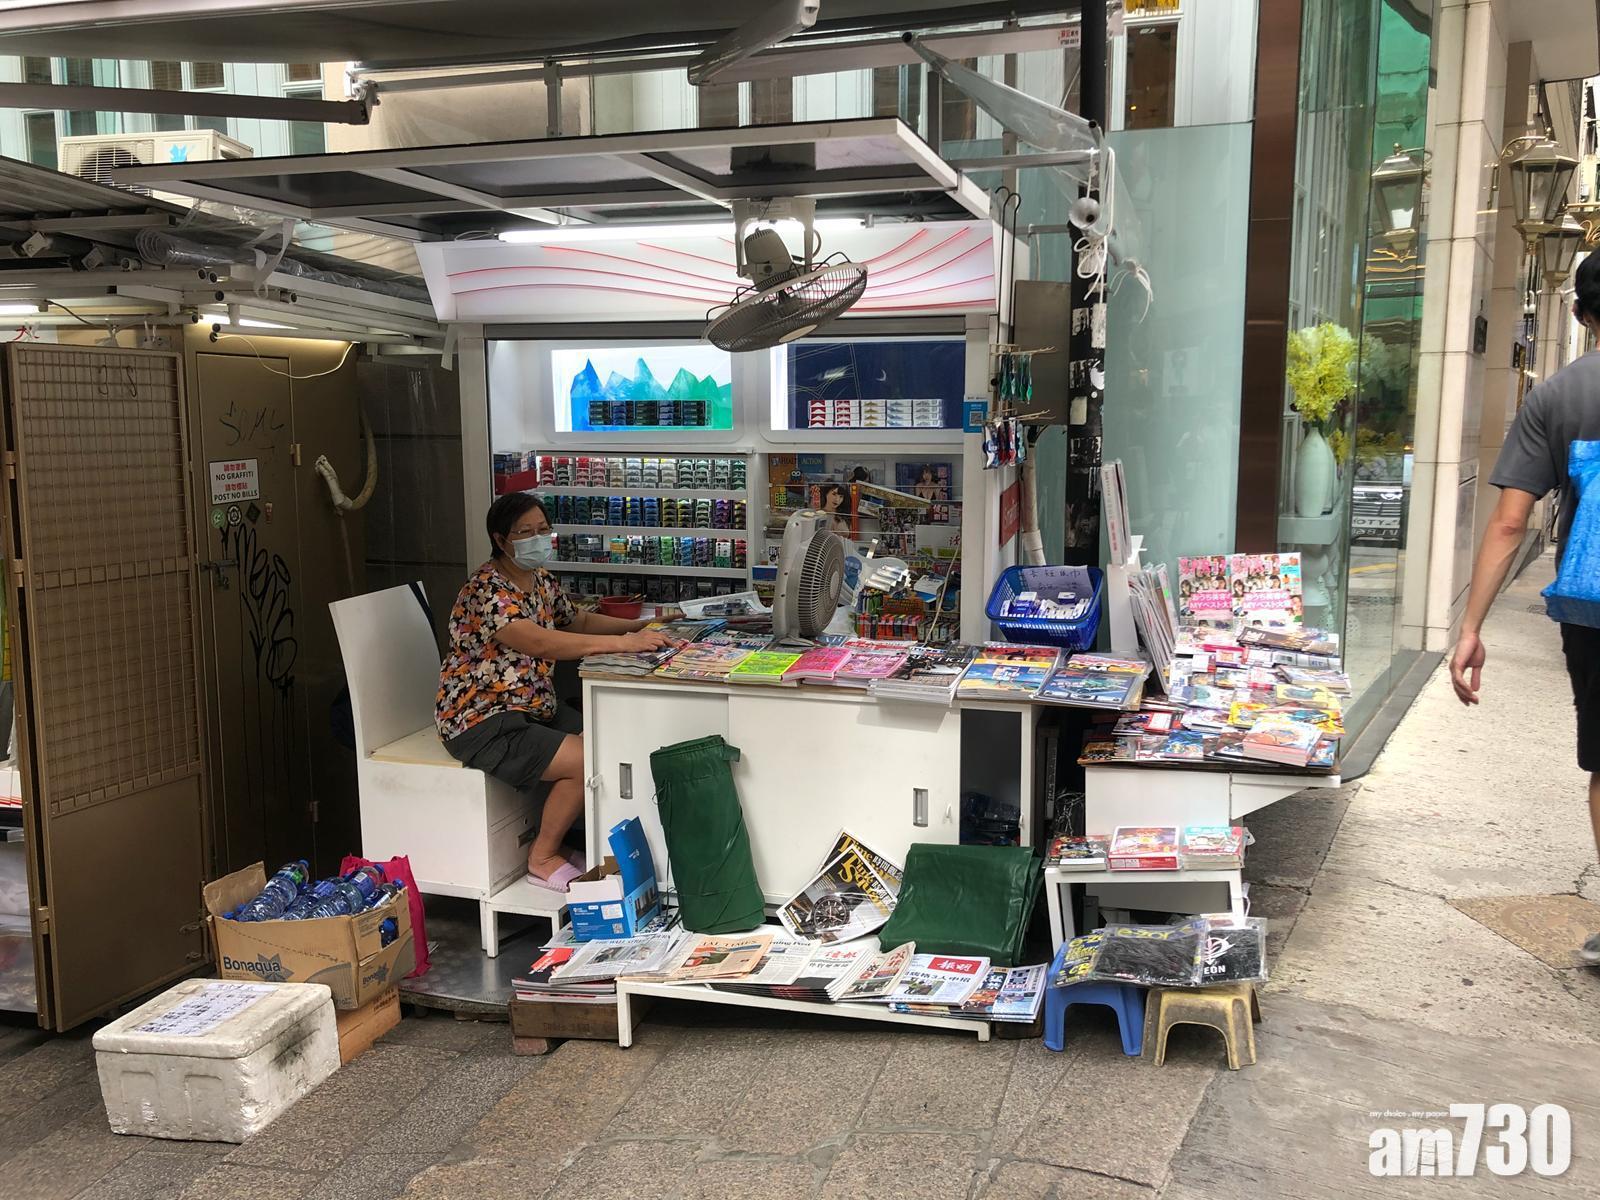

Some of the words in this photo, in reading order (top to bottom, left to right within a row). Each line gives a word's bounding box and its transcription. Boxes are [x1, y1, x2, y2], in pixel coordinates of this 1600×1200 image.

[215, 473, 226, 481] NO
[226, 471, 254, 480] GRAFFITI
[214, 493, 230, 501] POST
[242, 490, 258, 498] BILLS
[223, 956, 281, 974] Bonaqua
